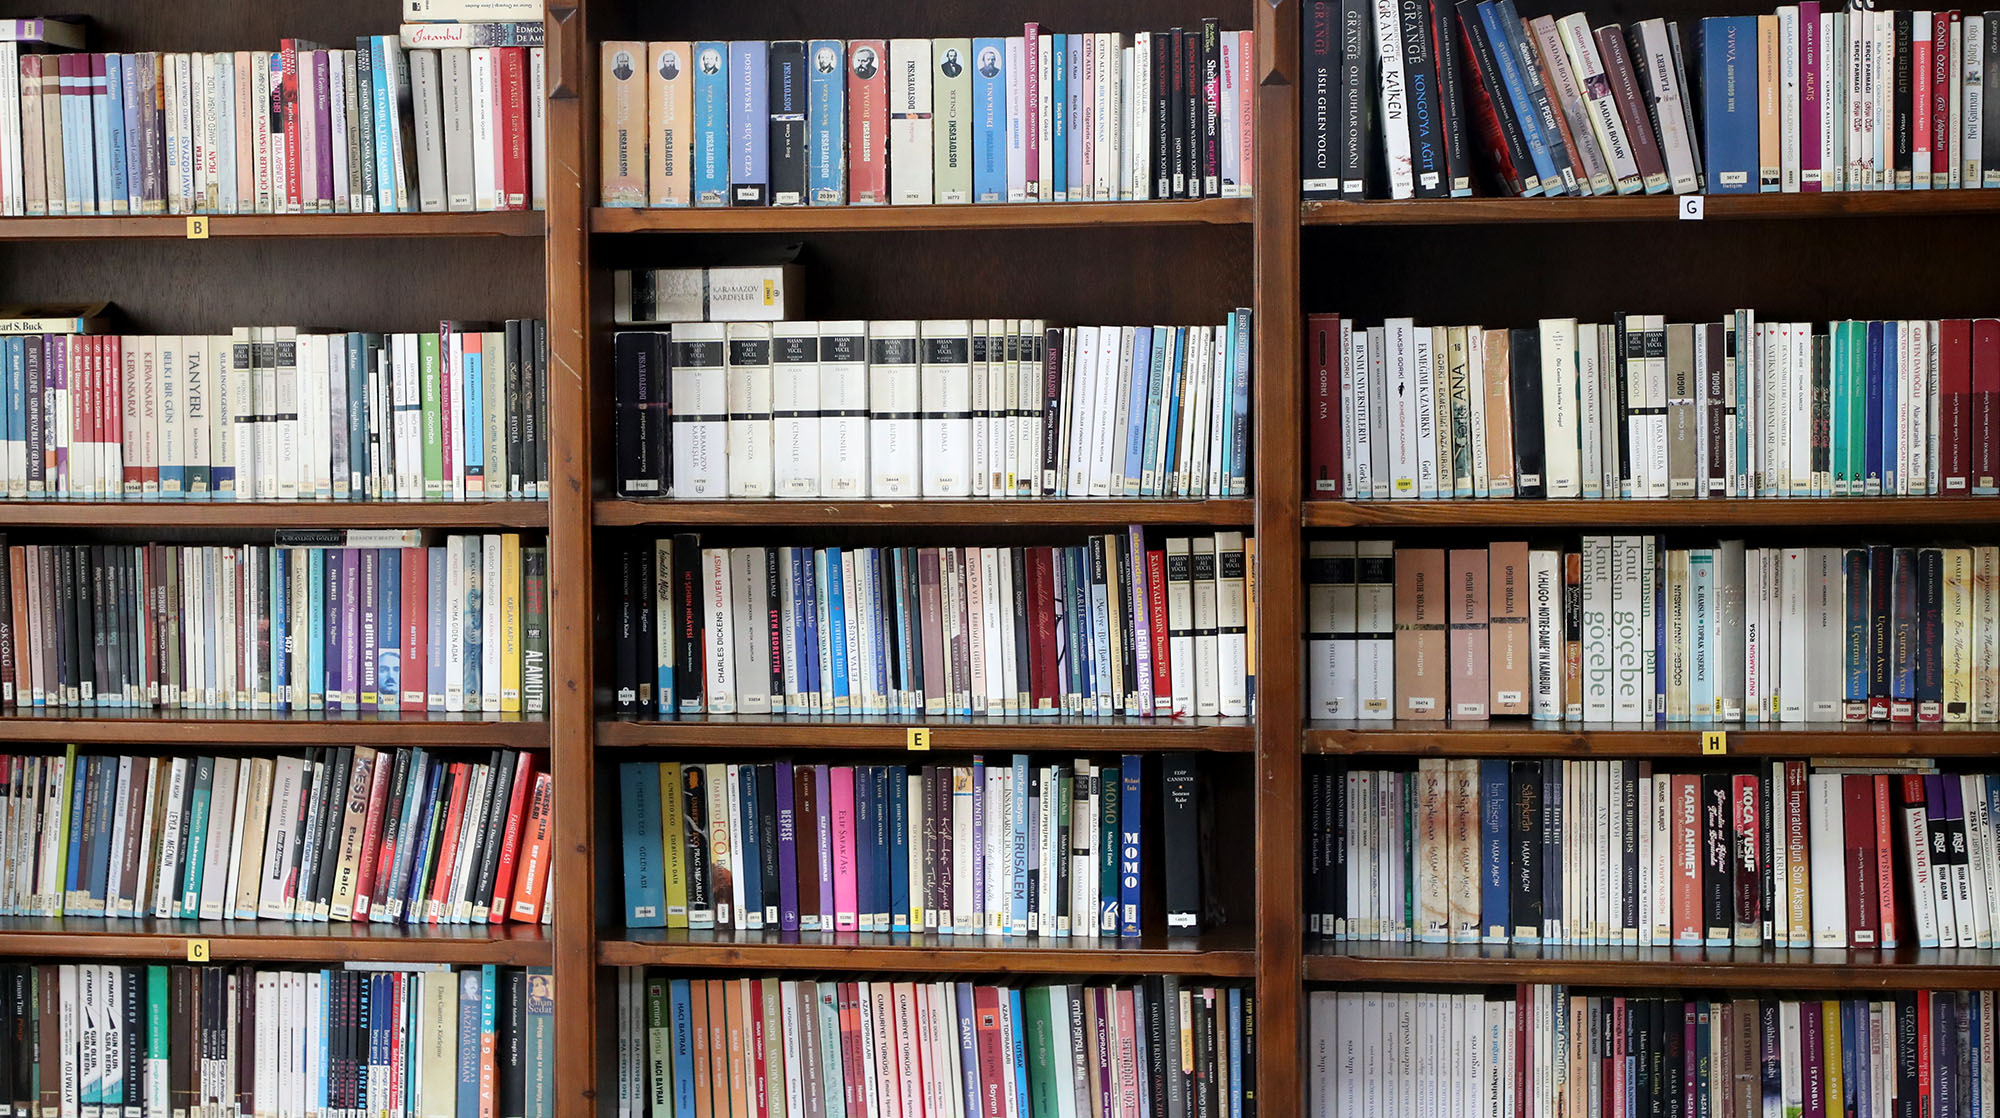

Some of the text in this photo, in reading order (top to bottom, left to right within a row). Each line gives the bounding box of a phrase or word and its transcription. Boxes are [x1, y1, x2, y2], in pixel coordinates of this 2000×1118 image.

[1403, 1, 1424, 64] GRANGÉ
[1937, 20, 1945, 85] GÖNÜL ÖZGÜL
[744, 53, 752, 112] DOSTOYEVSKİ
[907, 60, 915, 110] DOSTOYEVSKİ
[1206, 59, 1217, 136] Sherlock Holmes
[1347, 11, 1359, 168] GRANGÉ ÖLÜ RUHLAR ORMANI
[259, 116, 267, 156] SUSAYINCA
[743, 123, 752, 139] SUÇ
[862, 120, 871, 162] DOSTOYEVSKİ
[1414, 74, 1434, 170] KONGO'YA AĞIT
[1598, 101, 1625, 160] MADAM BOVARY
[182, 136, 190, 172] GÖZYAŞI
[664, 129, 673, 176] DOSTOYEVSKİ
[706, 131, 714, 179] DOSTOYEVSKİ
[745, 142, 752, 153] VE
[194, 221, 202, 234] B
[1687, 201, 1697, 213] G
[712, 285, 759, 294] KARAMAZOV
[713, 293, 755, 302] KARDEŞLER
[126, 351, 136, 418] KERVANSARAY
[144, 352, 153, 418] KERVANSARAY
[188, 351, 203, 419] TANYERİ
[638, 352, 647, 400] DOSTOYEVSKİ
[1048, 348, 1057, 398] DOSTOYEVSKİ
[1452, 363, 1466, 401] ANA
[1676, 371, 1685, 396] GOGOL
[1712, 371, 1721, 396] GOGOL
[165, 400, 176, 424] GÜN
[1418, 343, 1431, 480] EKMEĞİMİ KAZANIRKEN Gorki
[691, 425, 699, 467] KARDEŞLER
[488, 545, 496, 606] Gaston Bachelard
[968, 557, 978, 605] LYDIA DAVIS
[1133, 532, 1143, 585] alexandre
[715, 579, 723, 608] OLIVER
[1135, 587, 1144, 622] dumas
[1417, 572, 1425, 620] VICTOR HUGO
[1506, 565, 1514, 614] VICTOR HUGO
[285, 635, 293, 653] 1473
[451, 598, 459, 662] YIKIMA GİDEN ADAM
[715, 612, 724, 646] DICKENS
[770, 609, 781, 673] ŞEYH BEDRETTİN
[1137, 629, 1149, 660] DEMİR
[1584, 545, 1611, 696] knut göçebe
[1614, 545, 1641, 696] knut göçebe
[1874, 615, 1886, 654] Uçurtma
[364, 612, 374, 686] az gittik uz gittik
[716, 647, 725, 683] CHARLES
[1877, 656, 1886, 683] Avcısı
[1897, 623, 1910, 695] Uçurtma Avcısı
[525, 650, 545, 700] ALAMUT
[915, 733, 922, 745] E
[1710, 736, 1719, 750] H
[712, 778, 728, 855] UMBERTO ECO
[781, 809, 793, 841] BEŞPEŞE
[1105, 781, 1117, 824] MOMO
[164, 811, 179, 867] LEYLA MECNUN
[503, 813, 518, 864] FAHRENHEIT 451
[1014, 765, 1025, 900] markar esayan JERUSALEM
[1684, 785, 1695, 879] KARA AHMET
[1744, 786, 1755, 872] KOCA YUSUF
[1933, 831, 1945, 854] ATSIZ
[339, 826, 357, 896] Burak Balcı
[1123, 832, 1139, 888] MOMO
[1790, 790, 1804, 921] İmparatorluğun Son Akşamı
[1880, 847, 1891, 908] ADANMIŞLAR
[194, 944, 202, 957] C
[85, 970, 93, 1006] AYTMATOV
[128, 973, 136, 1024] AYTMATOV
[360, 978, 369, 1029] AYTMATOV
[463, 1005, 472, 1083] MAZHAR OSMAN
[677, 1002, 687, 1056] HACI BAYRAM
[961, 1018, 972, 1049] SANCI
[1015, 1039, 1024, 1068] TUTSAK
[1098, 1018, 1108, 1068] AK TOPRAKLAR
[1151, 1002, 1162, 1072] EMRULLAH ERDİNÇ
[1554, 992, 1567, 1084] Minyeli Abdullah
[1871, 1019, 1881, 1055] KARDELEN
[1904, 1006, 1916, 1078] GEZGİN ATLAR
[65, 1061, 73, 1104] AYTMATOV
[655, 1076, 664, 1105] BAYRAM
